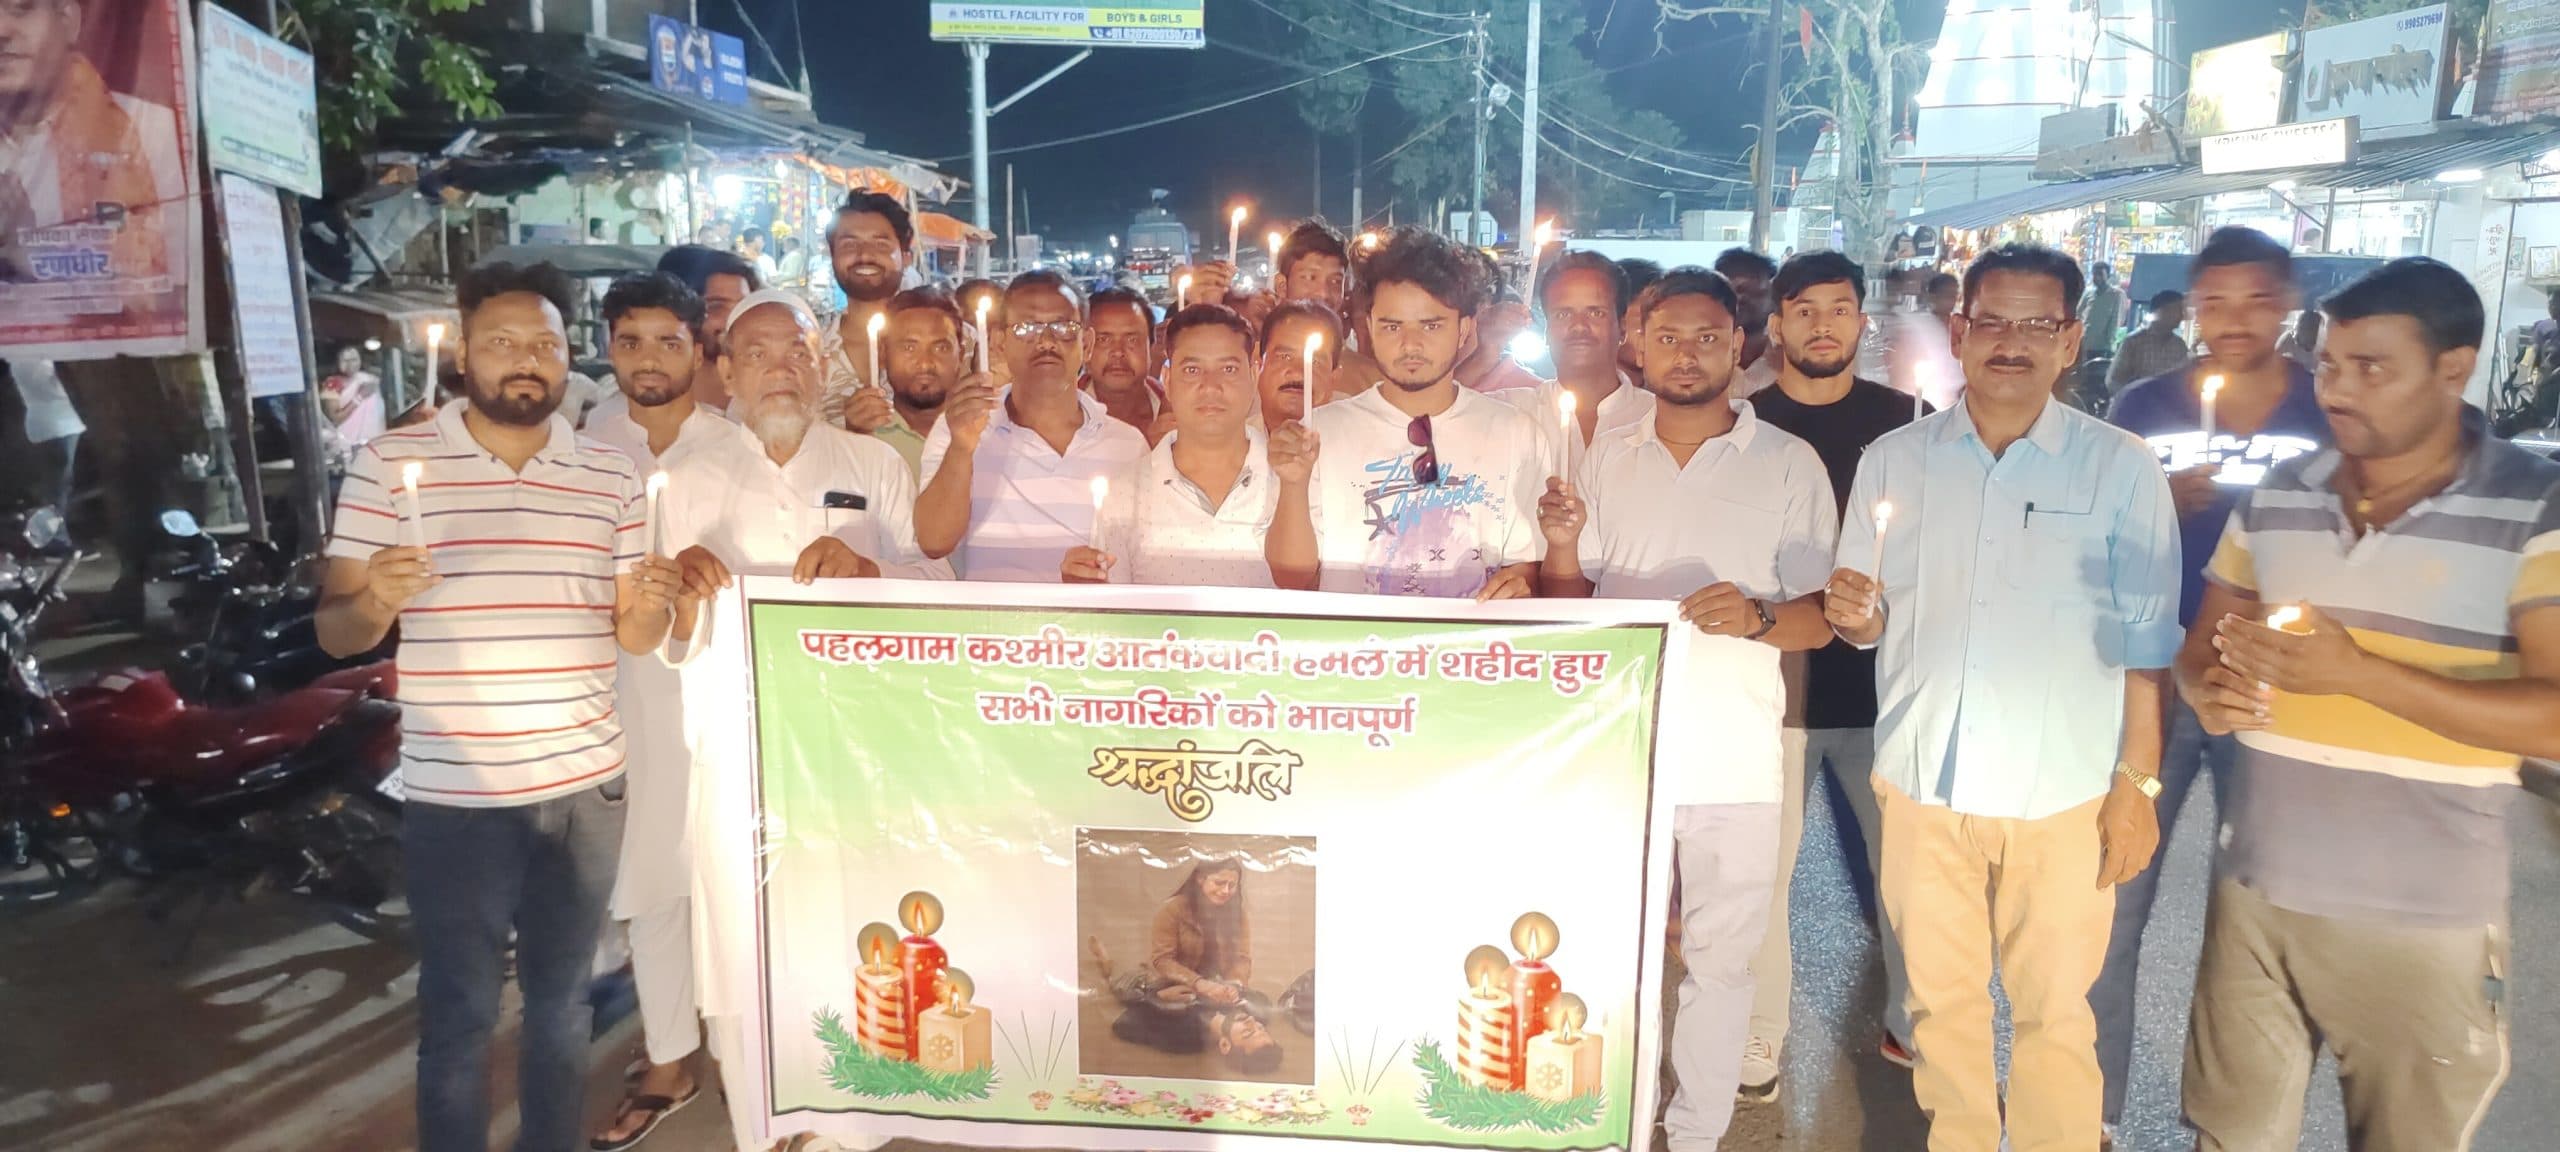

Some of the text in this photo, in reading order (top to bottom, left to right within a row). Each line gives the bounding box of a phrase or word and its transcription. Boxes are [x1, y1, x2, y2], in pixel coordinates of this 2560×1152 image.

[963, 9, 1007, 20] HOSTEL
[1010, 10, 1060, 21] FACILITY
[1063, 12, 1085, 22] FOR
[1106, 13, 1135, 23] BOYS
[1149, 14, 1182, 23] GIRLS
[32, 249, 110, 278] रणधीर
[801, 632, 957, 662] पहलगाम
[966, 626, 1087, 666] कश्मीर
[1096, 632, 1280, 672] आतंकवादी
[1396, 644, 1436, 676] में
[1441, 641, 1543, 681] शहीद
[1552, 654, 1608, 693] हुए
[980, 686, 1416, 747] सभी नागरिकों को भावपूर्ण
